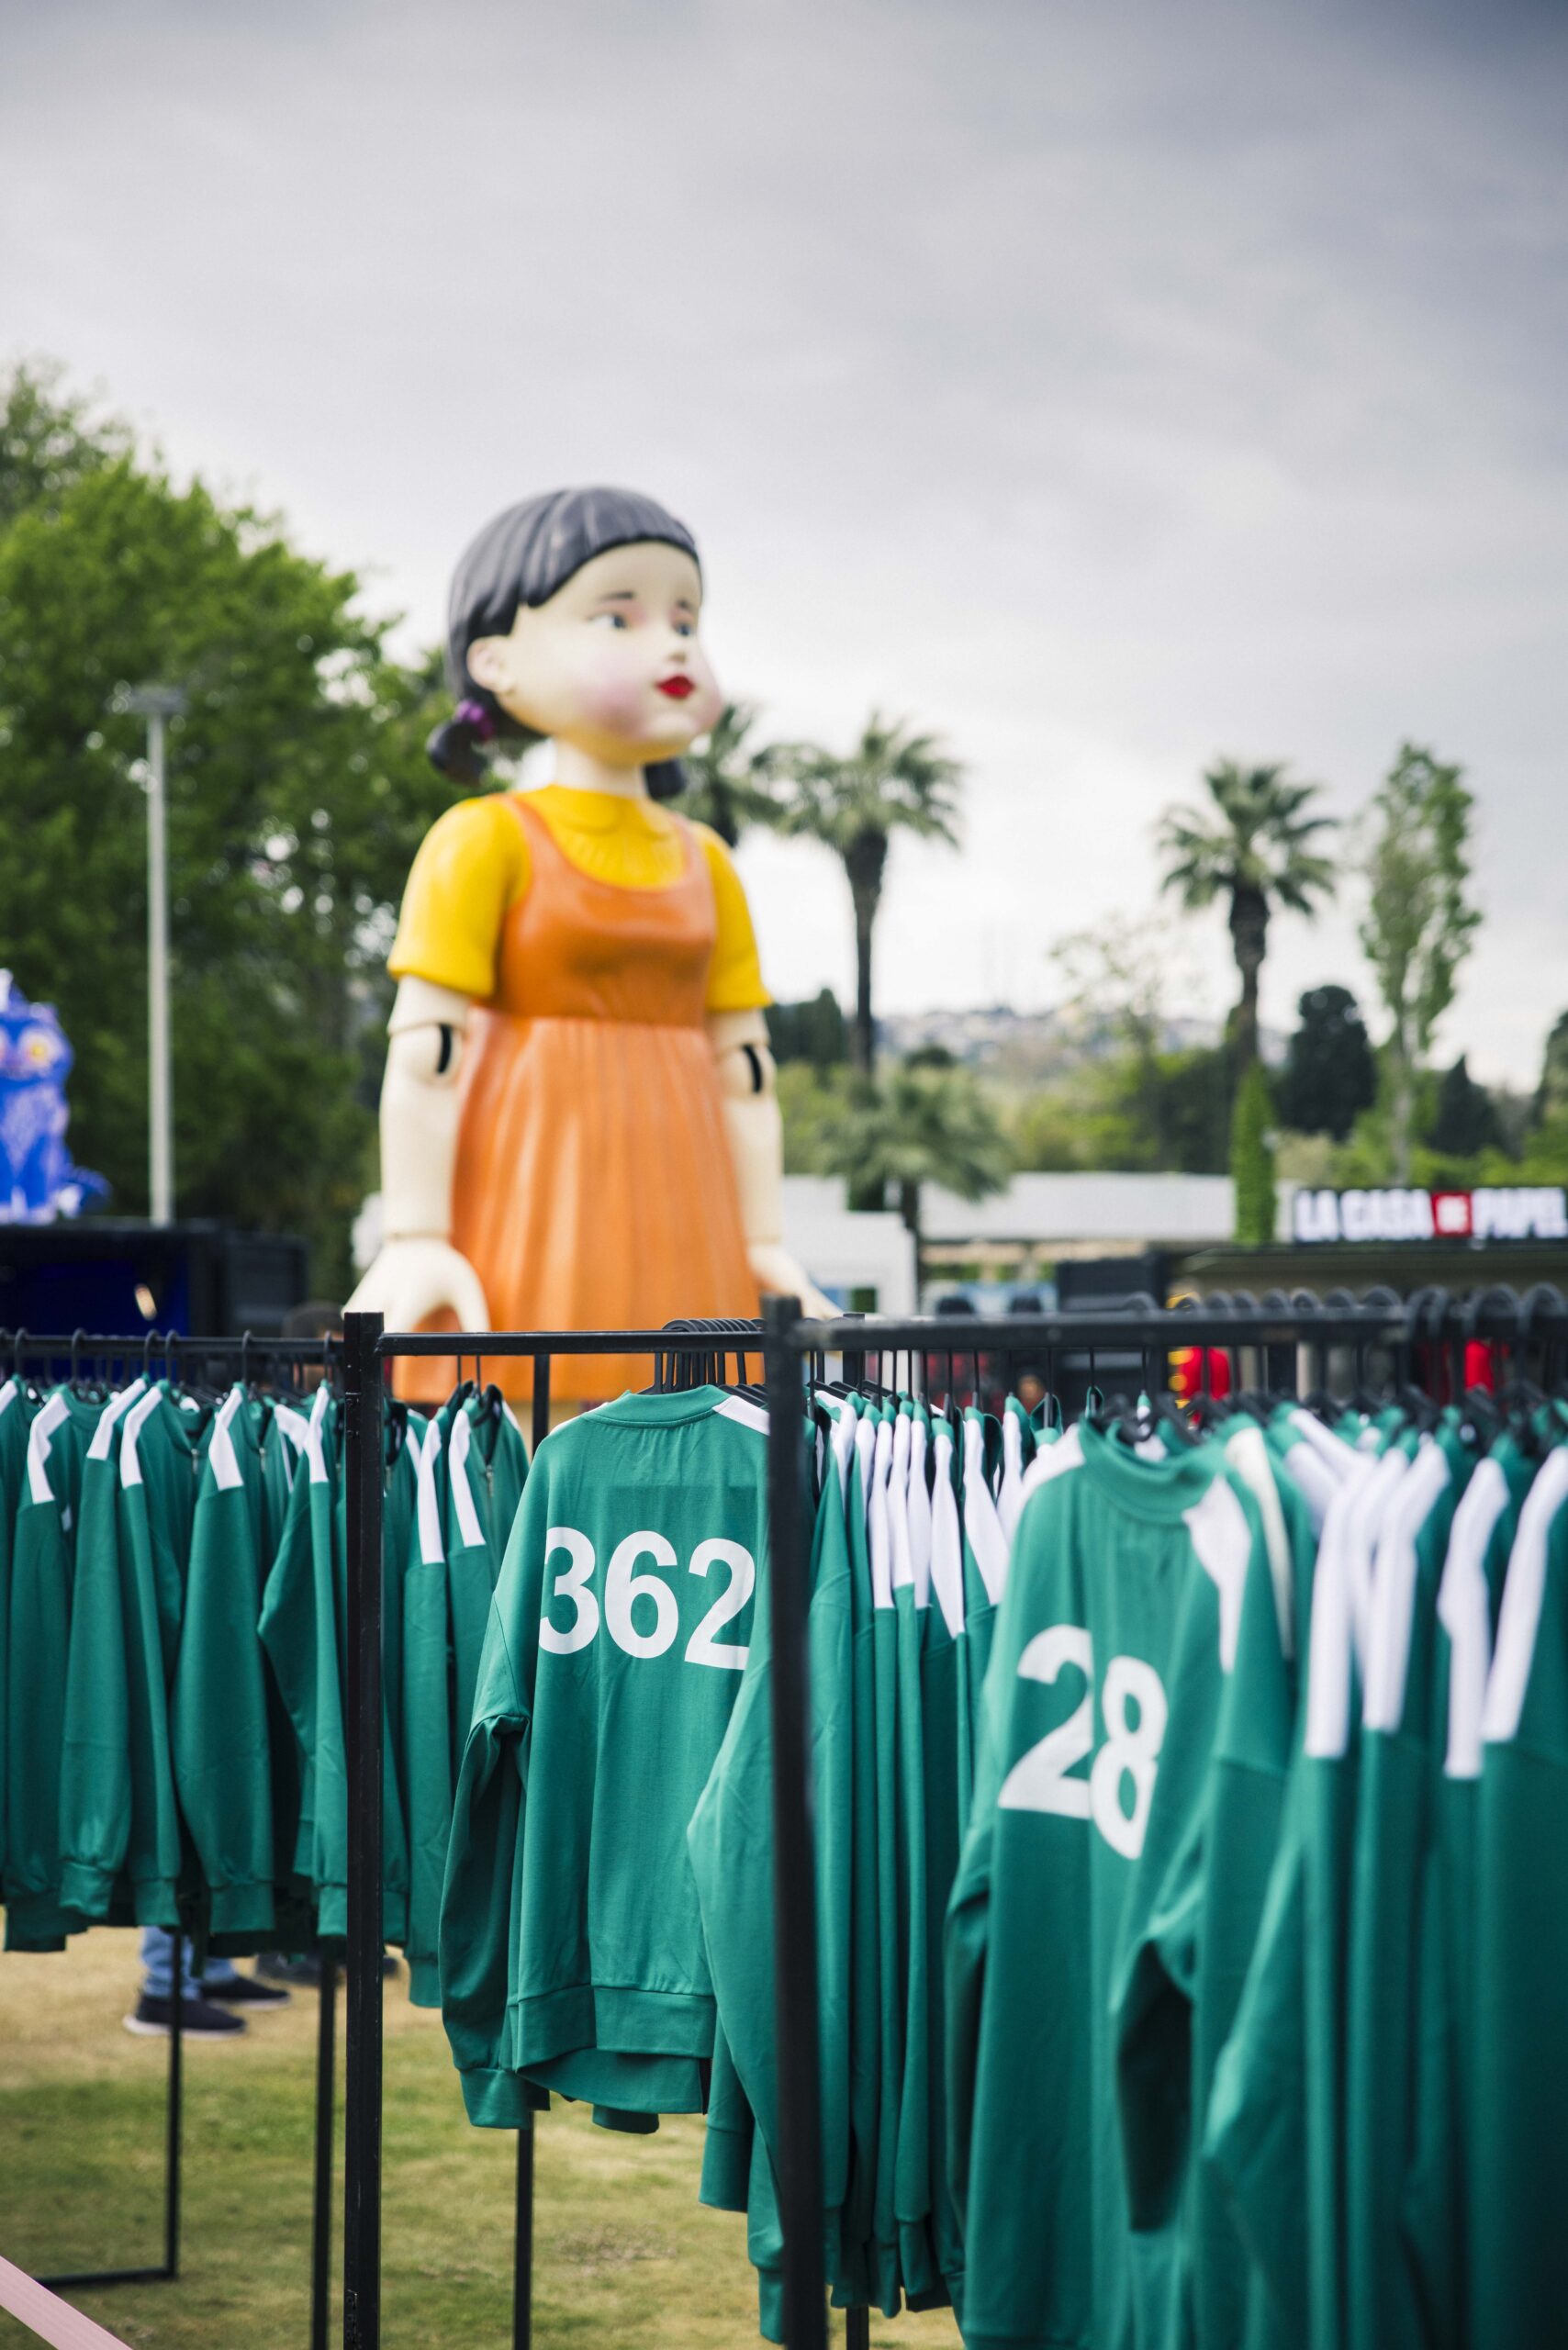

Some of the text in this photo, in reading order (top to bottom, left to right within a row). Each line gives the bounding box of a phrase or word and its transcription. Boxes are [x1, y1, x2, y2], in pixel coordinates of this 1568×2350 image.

[1294, 1189, 1338, 1241] LA
[539, 1527, 755, 1670] 362
[998, 1624, 1169, 1860] 28
